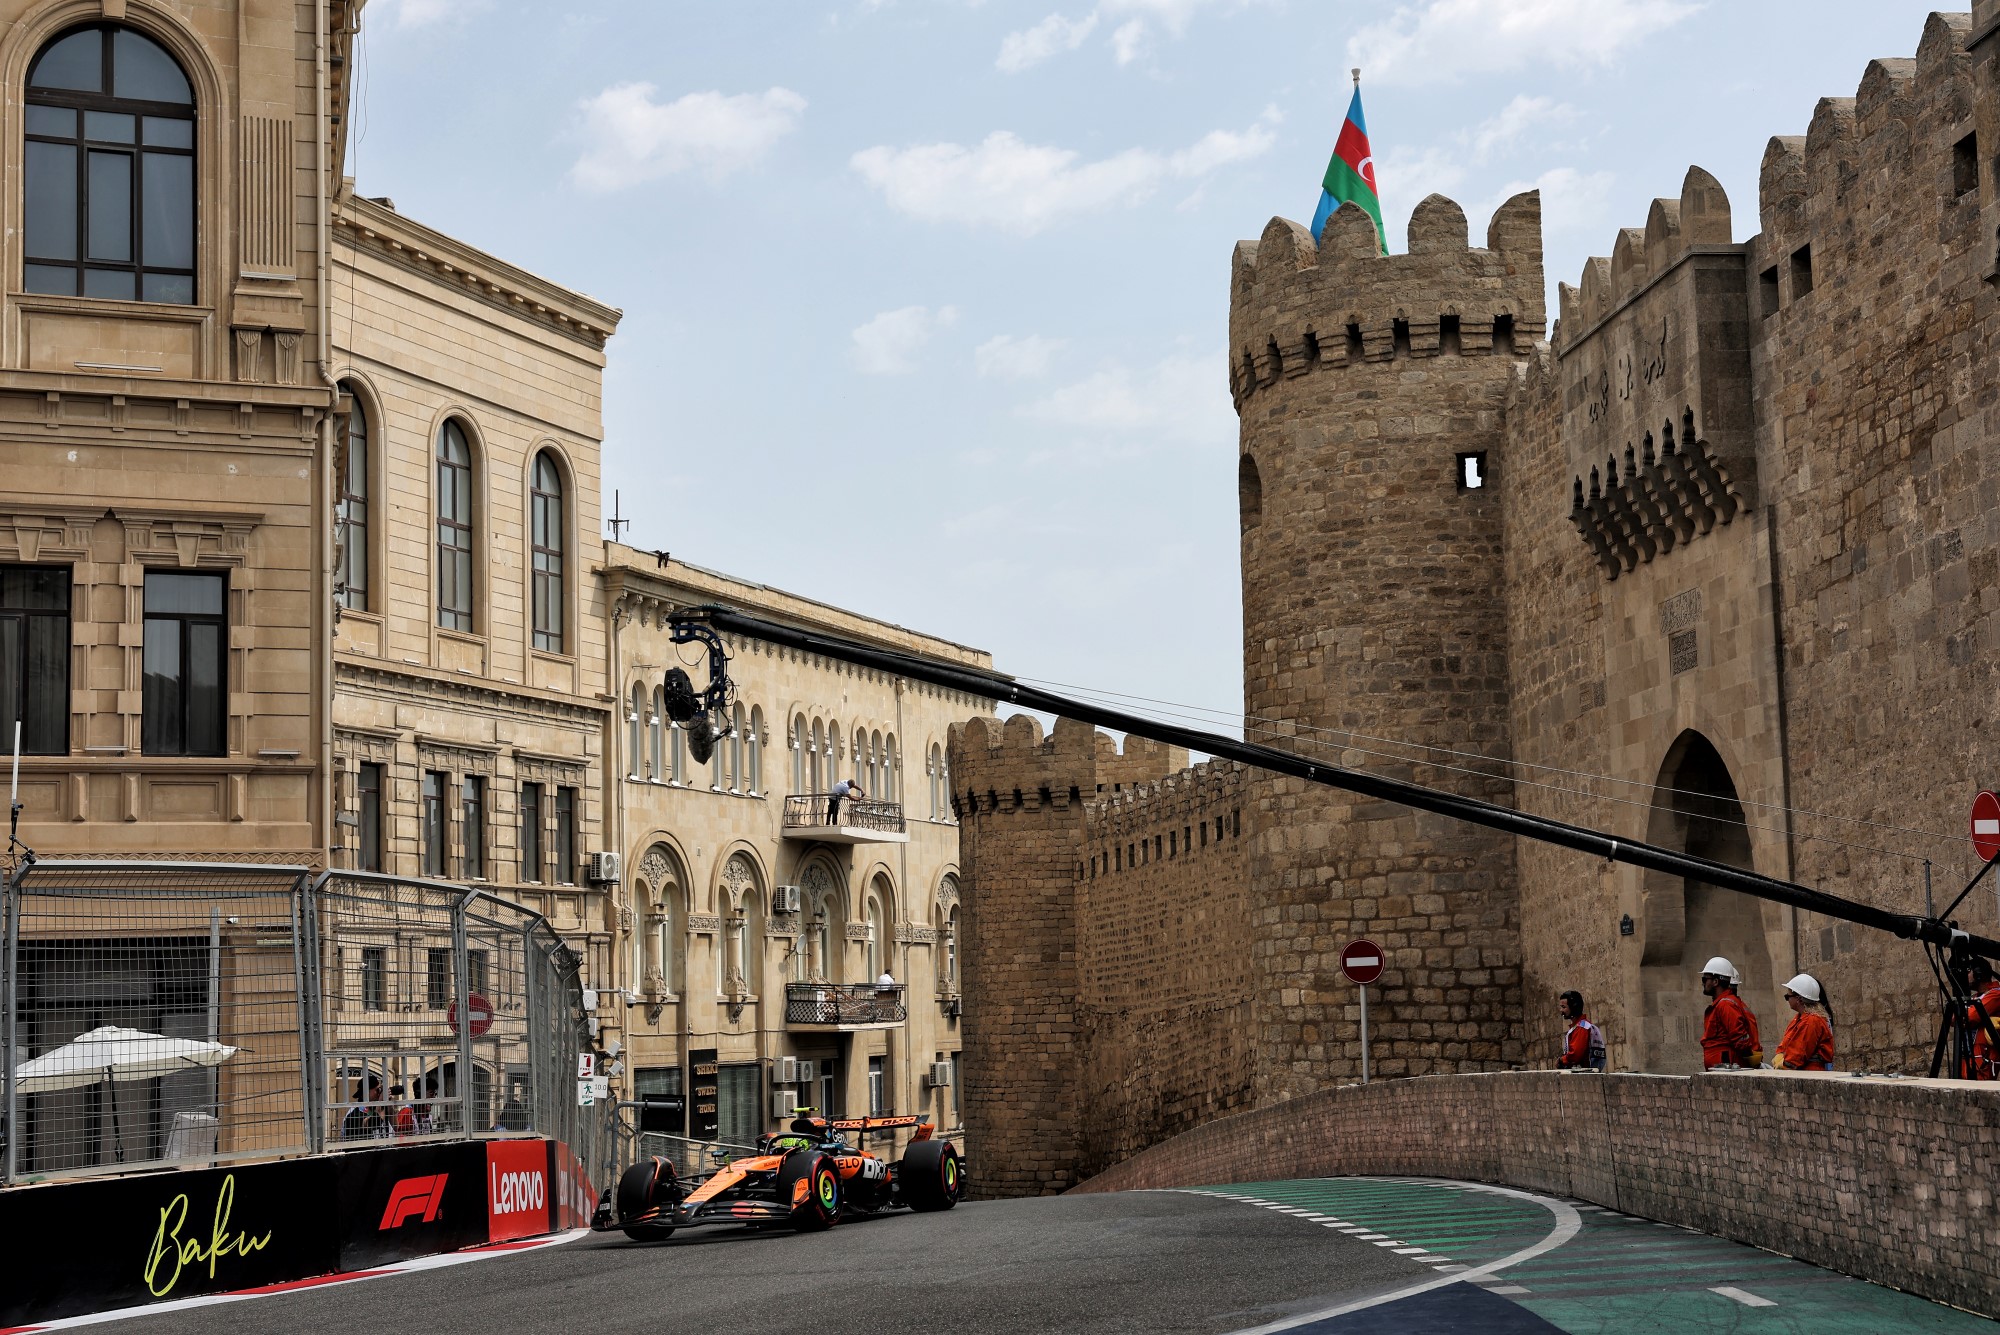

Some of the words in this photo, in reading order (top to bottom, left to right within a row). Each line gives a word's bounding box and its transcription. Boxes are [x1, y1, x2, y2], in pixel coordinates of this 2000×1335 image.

[697, 1103, 716, 1114] HOME
[378, 1172, 449, 1231] F1
[492, 1161, 544, 1215] Lenovo
[144, 1173, 272, 1297] Baku
